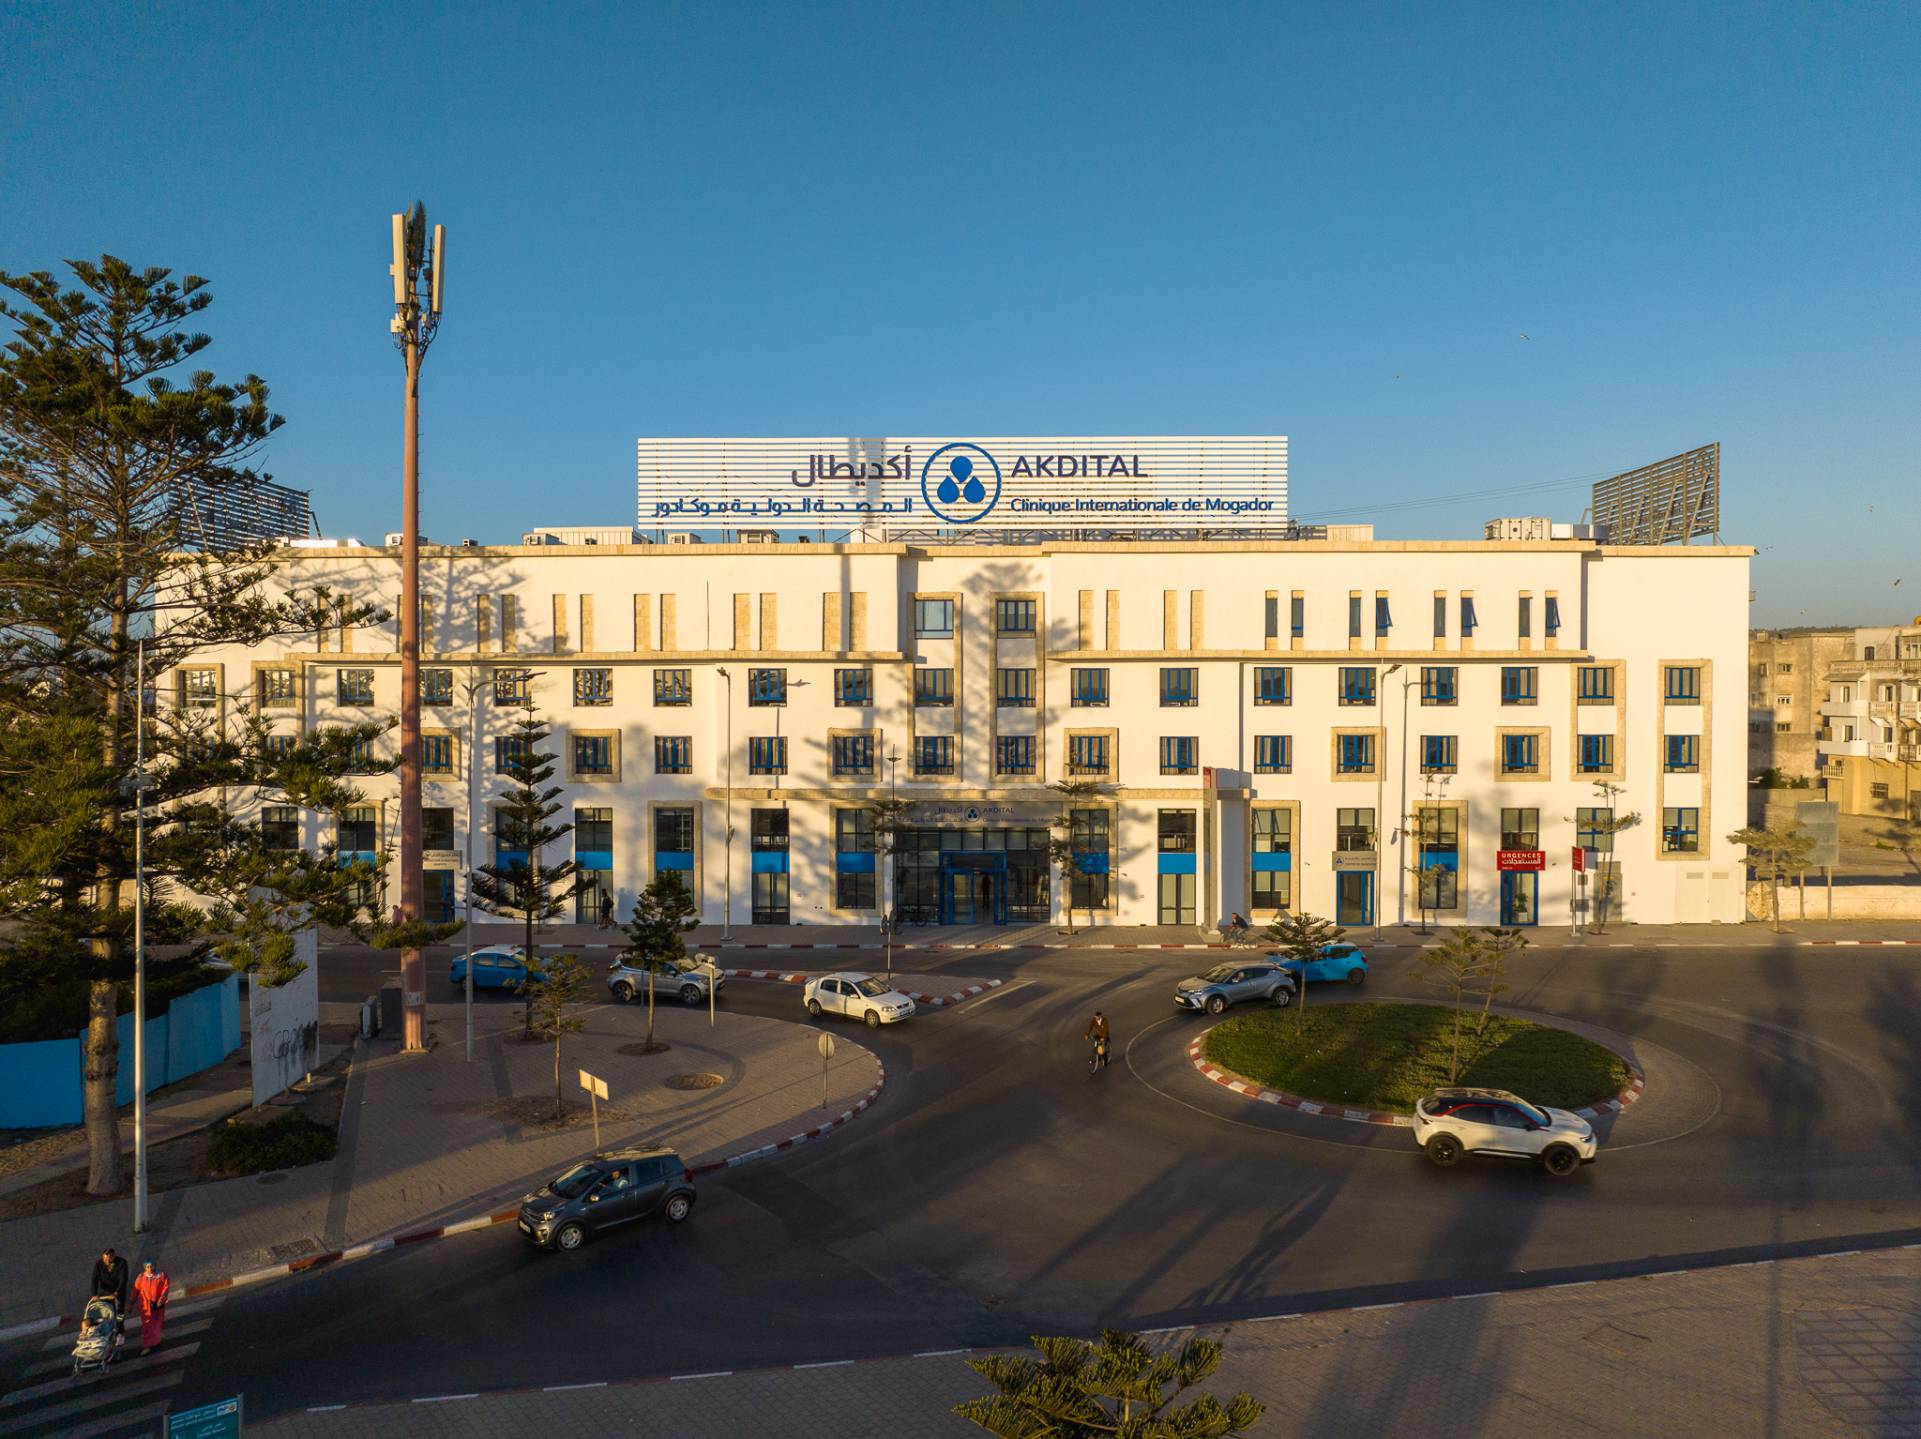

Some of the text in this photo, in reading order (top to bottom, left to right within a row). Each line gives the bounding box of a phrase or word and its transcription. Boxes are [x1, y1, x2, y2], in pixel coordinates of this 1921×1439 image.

[791, 445, 912, 487] أكديطال
[1011, 454, 1149, 478] AKDITAL
[813, 498, 912, 513] المصحة
[1010, 498, 1274, 515] Clinique Internationale de Mogador
